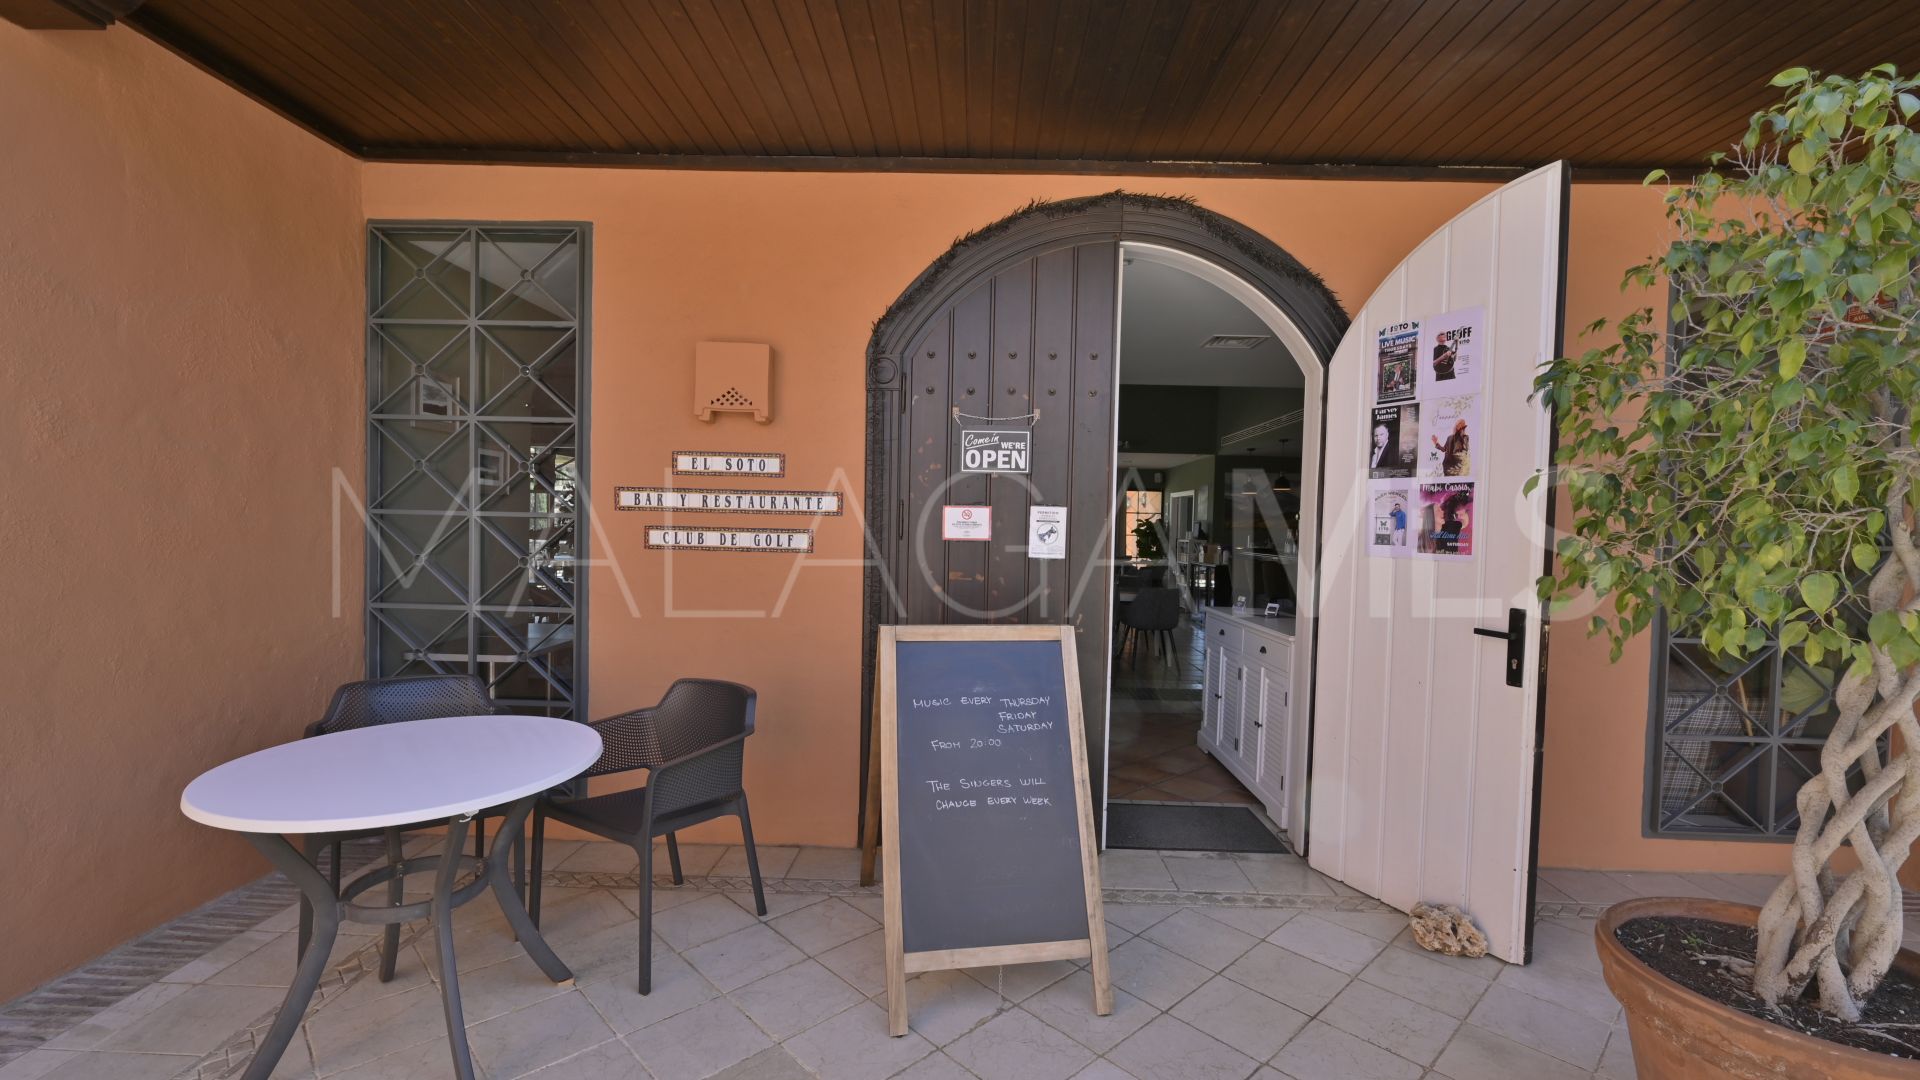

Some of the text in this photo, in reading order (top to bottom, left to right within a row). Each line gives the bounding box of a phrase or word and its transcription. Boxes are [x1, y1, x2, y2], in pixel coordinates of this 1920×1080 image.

[1381, 335, 1416, 349] LIVE MUSIC
[1376, 413, 1398, 421] James
[965, 433, 1000, 448] Come in
[1001, 441, 1026, 450] WE'RE
[691, 457, 766, 472] EL SOTO
[965, 449, 1026, 469] OPEN
[634, 493, 823, 510] BAR Y RESTAURANTE
[662, 532, 794, 548] CLUB DE GOLF
[913, 696, 1050, 709] MUSIC EVERY THURSDAY
[998, 711, 1037, 722] FRIDAY
[997, 721, 1053, 734] SATURDAY
[930, 739, 961, 751] FROM
[925, 777, 1046, 793] THE SINGERS WILL
[987, 796, 1018, 806] EVERY
[1022, 796, 1052, 806] WEEK
